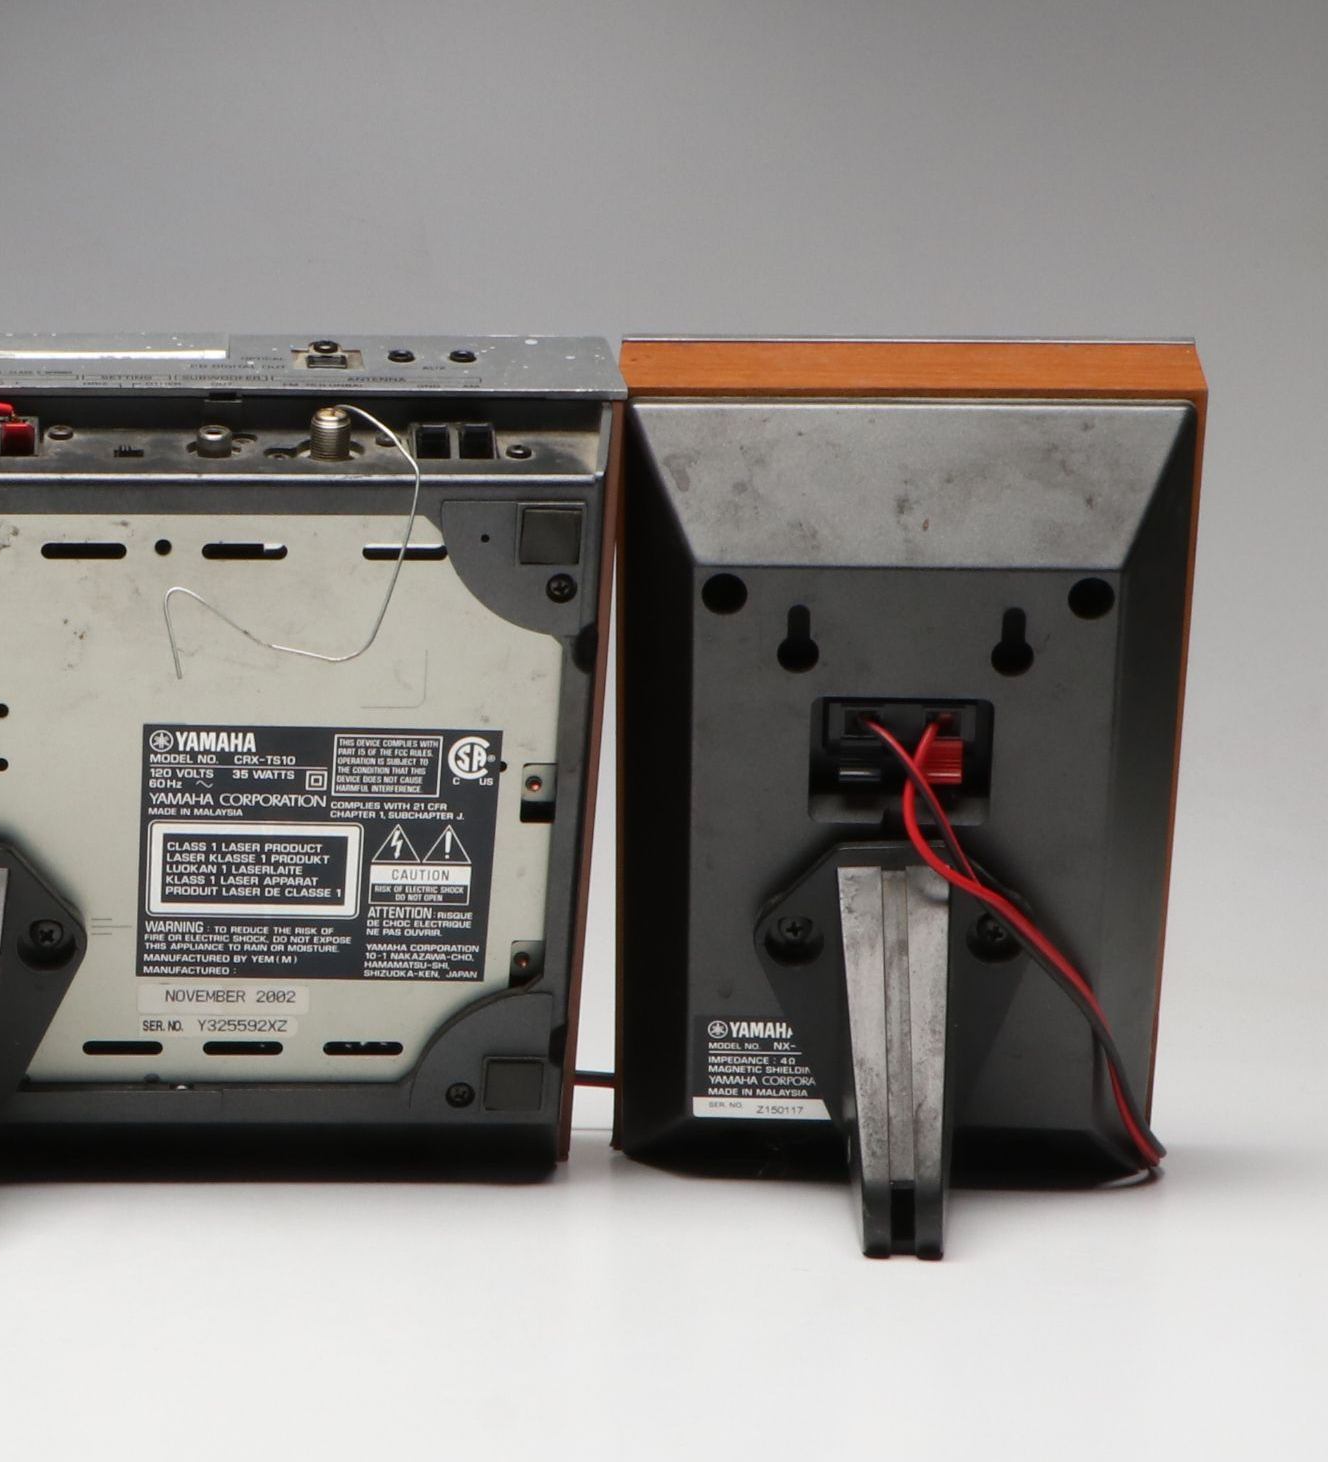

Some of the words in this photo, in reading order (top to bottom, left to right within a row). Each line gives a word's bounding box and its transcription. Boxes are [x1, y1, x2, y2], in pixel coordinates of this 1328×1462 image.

[176, 732, 256, 752] YAMAHA
[339, 739, 354, 747] THIS
[356, 739, 380, 747] DEVICE
[420, 740, 438, 748] WITH
[149, 754, 195, 763] MODEL
[197, 755, 218, 764] NO.
[234, 755, 296, 765] CRX-TS10
[338, 757, 376, 765] OPERATION
[378, 757, 384, 765] IS
[420, 758, 428, 766] TO
[150, 769, 172, 777] 120
[176, 769, 214, 778] VOLTS
[232, 770, 248, 779] 35
[253, 770, 295, 779] WATTS
[149, 793, 214, 805] YAMAHA
[220, 793, 327, 807] CORPORATION
[330, 802, 380, 810] COMPLIES
[384, 802, 410, 810] WITH
[194, 808, 243, 816] MALAYSIA
[330, 810, 379, 818] CHAPTER
[388, 811, 454, 820] SUBCHAPTER
[167, 842, 206, 851] CLASS
[212, 843, 217, 851] 1
[222, 843, 260, 851] LASER
[265, 844, 322, 853] PRODUCT
[166, 853, 204, 862] LASER
[210, 854, 256, 863] KLASSE
[261, 855, 266, 863] 1
[271, 855, 330, 864] PRODUKT
[166, 865, 217, 873] LUOKAN
[222, 865, 227, 873] 1
[232, 865, 303, 875] LASERLAITE
[392, 869, 449, 881] CAUTION
[166, 876, 205, 884] KLASS
[210, 876, 215, 884] 1
[221, 876, 259, 885] LASER
[263, 877, 319, 886] APPARAT
[165, 886, 218, 895] PRODUIT
[222, 887, 260, 896] LASER
[265, 888, 281, 896] DE
[285, 888, 331, 897] CLASSE
[336, 889, 341, 897] 1
[368, 907, 432, 919] ATTENTION
[437, 912, 473, 920] RISQUE
[145, 921, 204, 933] WARNING
[231, 926, 269, 934] REDUCE
[321, 927, 334, 935] OF
[290, 936, 309, 944] NOT
[313, 936, 352, 944] EXPOSE
[170, 943, 224, 951] APPLIANCE
[244, 944, 267, 952] RAIN
[271, 944, 284, 952] OR
[410, 944, 480, 952] CORPORATION
[144, 954, 230, 963] MANUFACTURED
[233, 955, 247, 963] BY
[143, 966, 230, 974] MANUFACTURED
[165, 990, 245, 1003] NOVEMBER
[256, 990, 296, 1003] 2002
[142, 1021, 165, 1031] SER.
[168, 1021, 183, 1031] NO.
[197, 1020, 288, 1032] Y325592XZ
[708, 1075, 758, 1085] YAMAHA
[756, 1089, 808, 1097] MALAYSIA
[756, 1106, 803, 1114] Z150117
